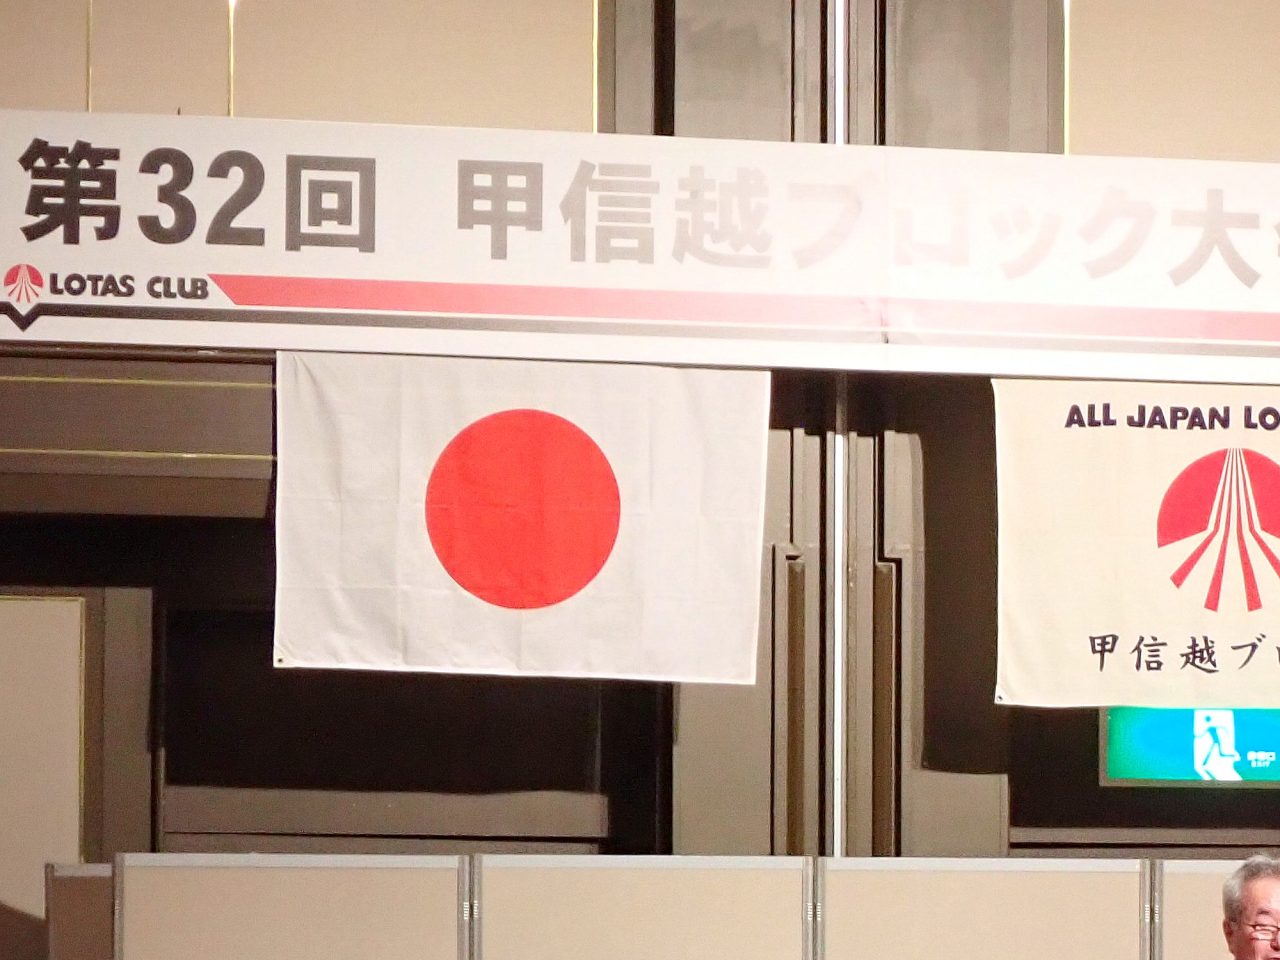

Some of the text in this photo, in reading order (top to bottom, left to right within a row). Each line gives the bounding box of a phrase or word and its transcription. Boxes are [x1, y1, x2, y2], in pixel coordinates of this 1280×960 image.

[17, 137, 377, 253] 第32回
[49, 272, 209, 300] LOTAS CLUB
[1064, 402, 1117, 428] ALL
[1126, 404, 1231, 431] JAPAN
